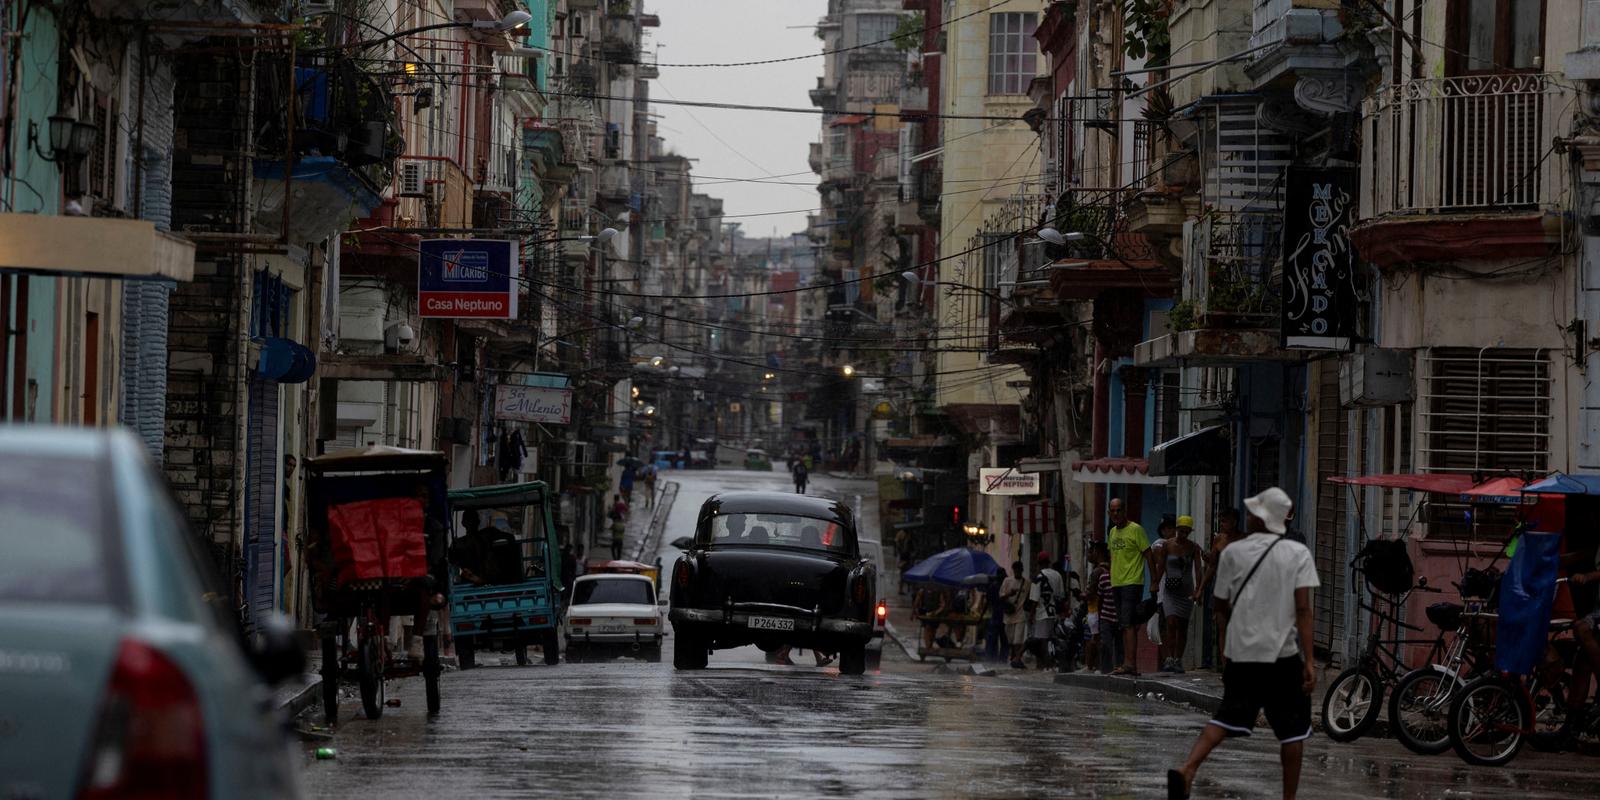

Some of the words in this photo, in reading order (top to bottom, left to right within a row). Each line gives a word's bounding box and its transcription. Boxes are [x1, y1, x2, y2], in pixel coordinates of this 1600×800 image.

[426, 297, 453, 310] Casa
[454, 297, 503, 313] Neptuno
[504, 398, 562, 415] Milenio
[761, 618, 776, 628] 264
[777, 620, 793, 630] 332
